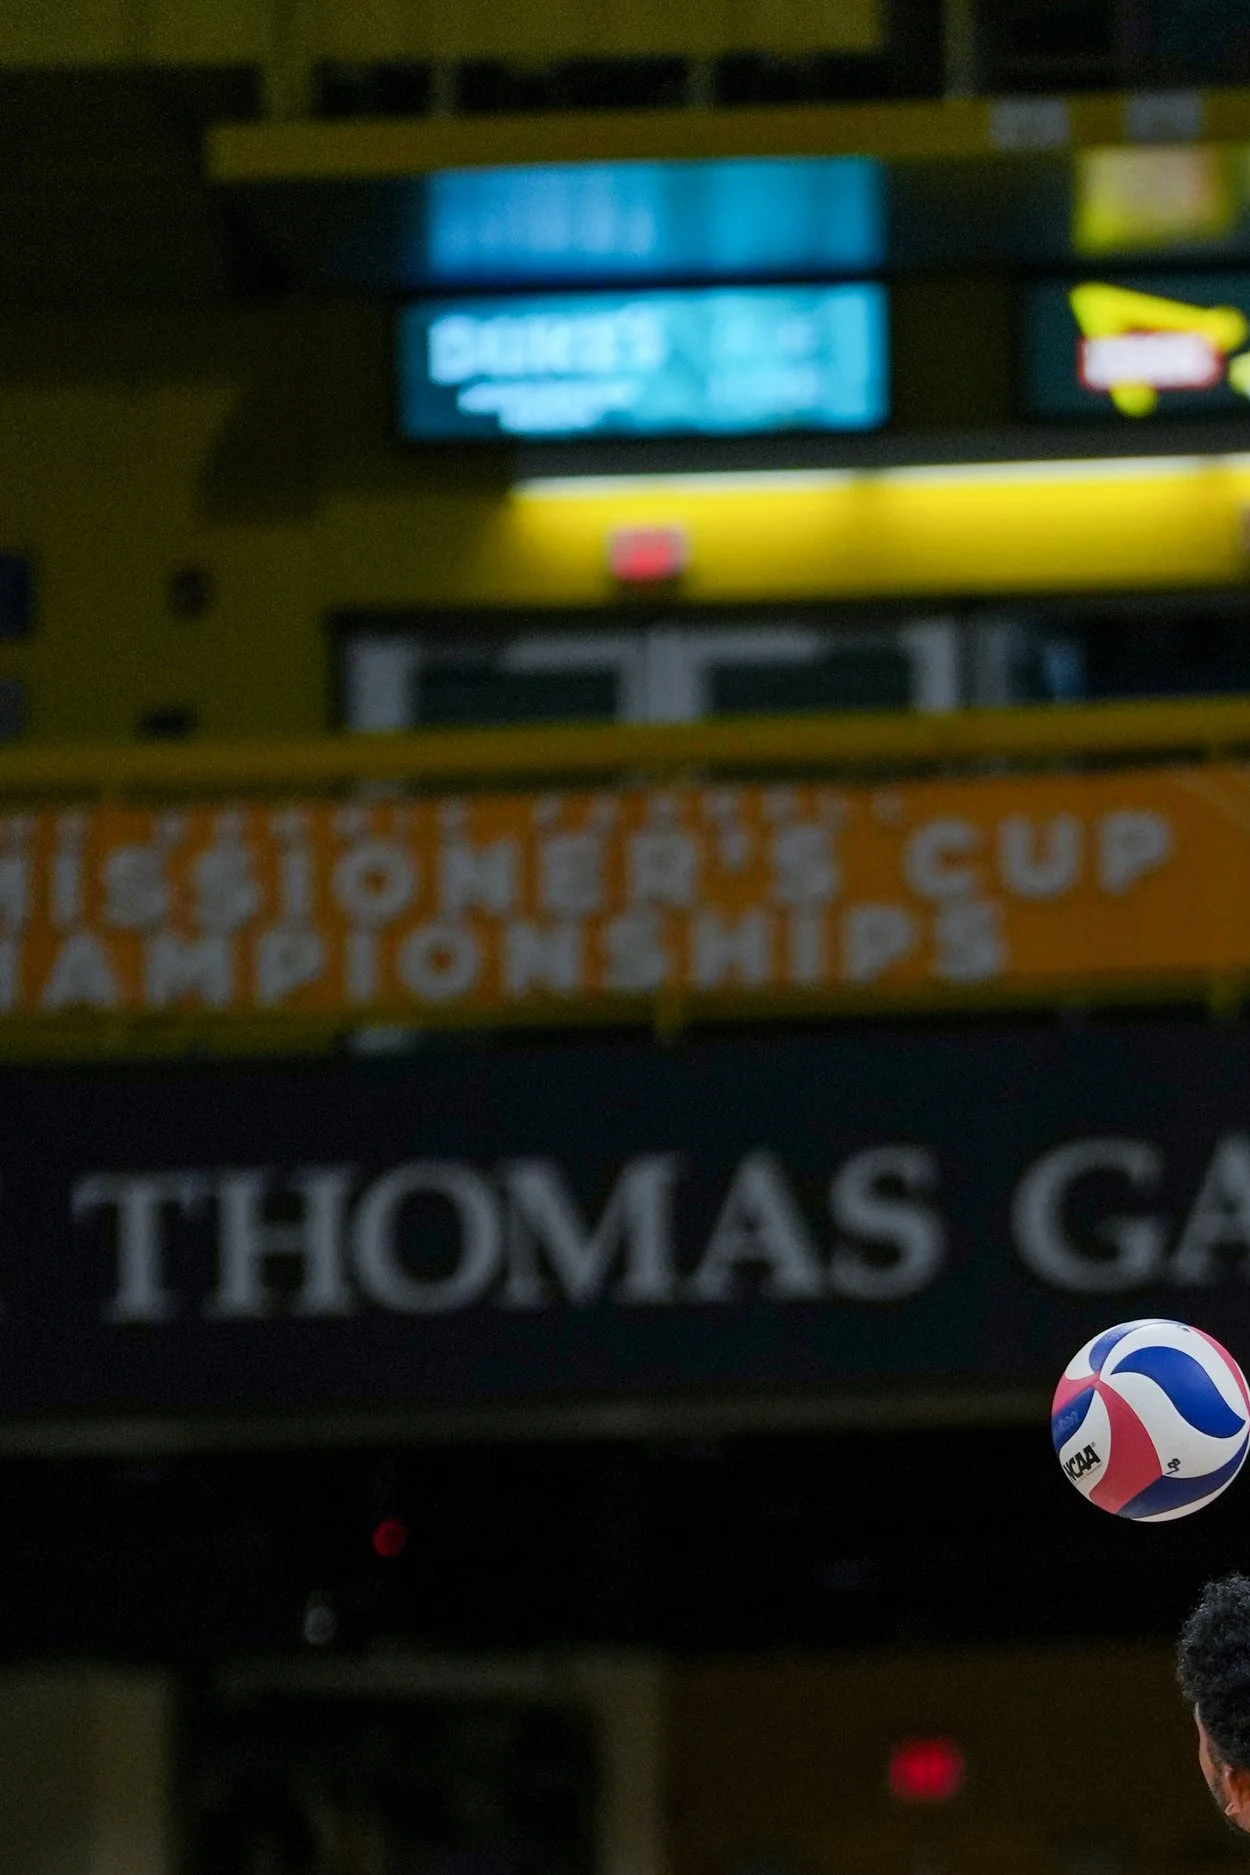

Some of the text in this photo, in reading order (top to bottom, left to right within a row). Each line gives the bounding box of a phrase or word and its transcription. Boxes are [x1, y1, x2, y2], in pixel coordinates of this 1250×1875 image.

[905, 811, 1172, 900] CUP
[0, 903, 1010, 1010] AMPIONSHIPS
[70, 1145, 946, 1325] THOMAS
